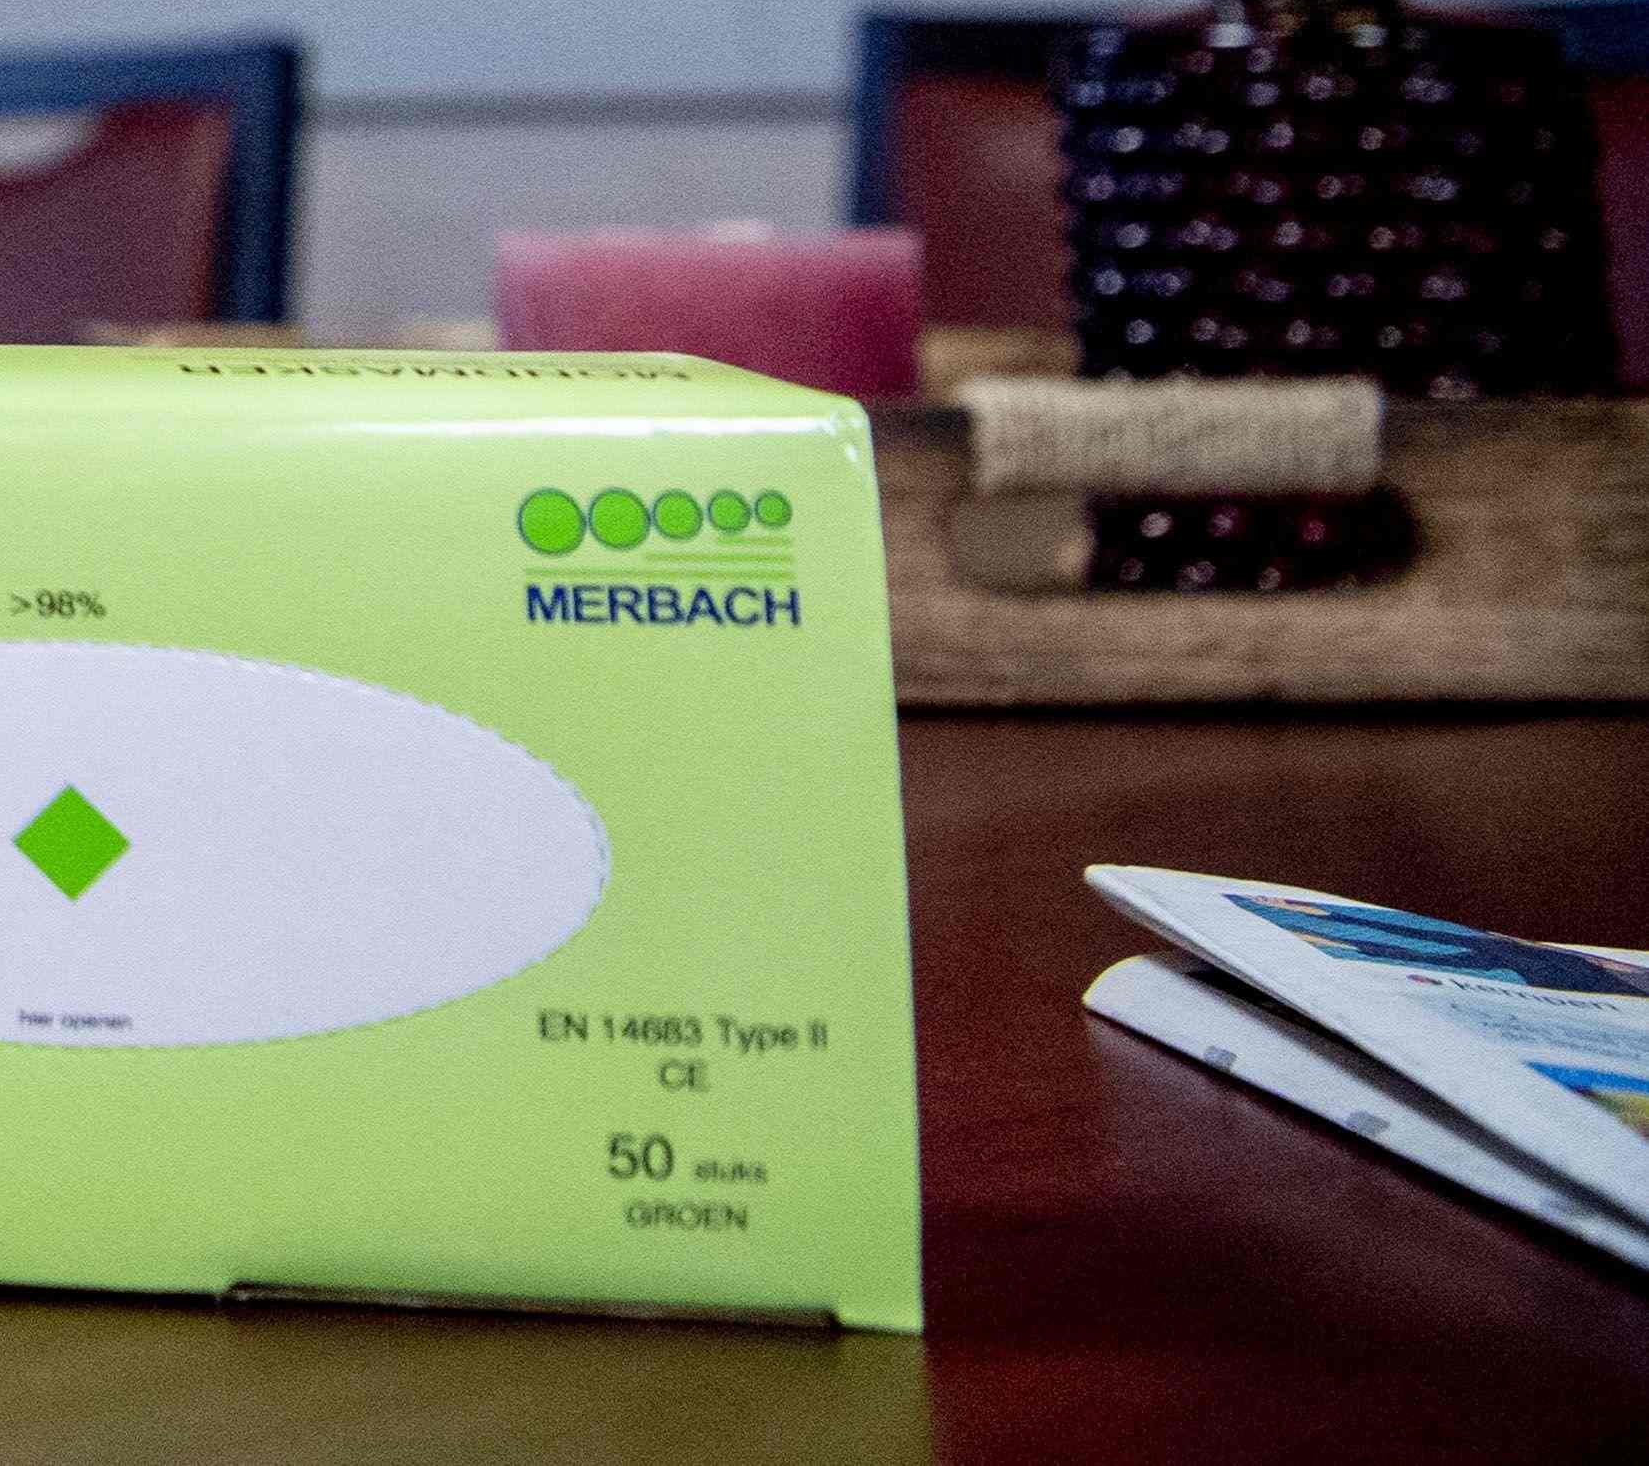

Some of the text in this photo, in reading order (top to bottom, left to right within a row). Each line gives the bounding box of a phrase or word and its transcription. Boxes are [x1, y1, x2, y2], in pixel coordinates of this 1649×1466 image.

[10, 591, 106, 617] >98%
[527, 585, 800, 626] MERBACH
[539, 1013, 588, 1041] EN
[603, 1017, 702, 1043] 14683
[716, 1017, 798, 1054] Type
[659, 1063, 709, 1088] CE
[608, 1133, 675, 1180] 50
[626, 1205, 748, 1230] GROEN
